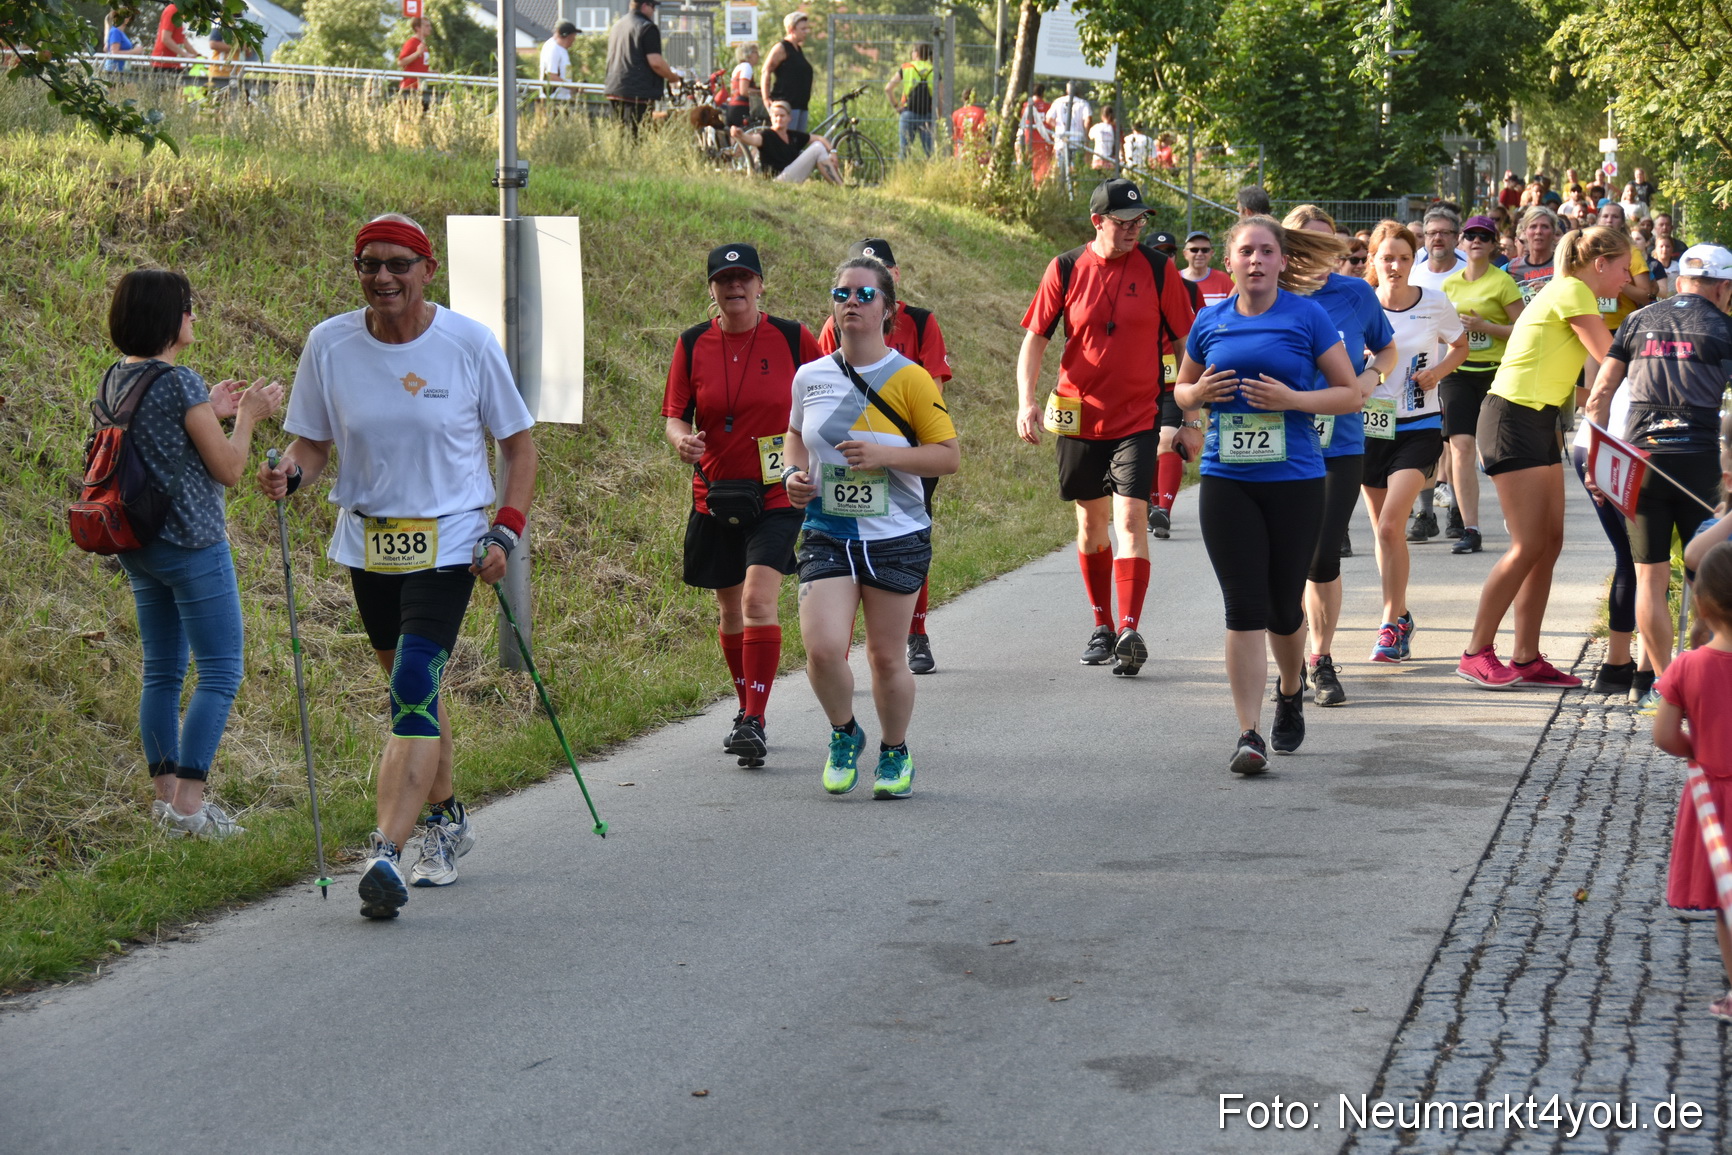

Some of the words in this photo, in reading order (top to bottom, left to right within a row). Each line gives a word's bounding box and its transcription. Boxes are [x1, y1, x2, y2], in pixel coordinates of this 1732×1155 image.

[761, 358, 769, 370] 3
[1164, 365, 1172, 375] 9
[1414, 352, 1428, 409] HUER
[1233, 431, 1269, 449] 572
[834, 484, 872, 503] 623
[372, 532, 427, 554] 1338
